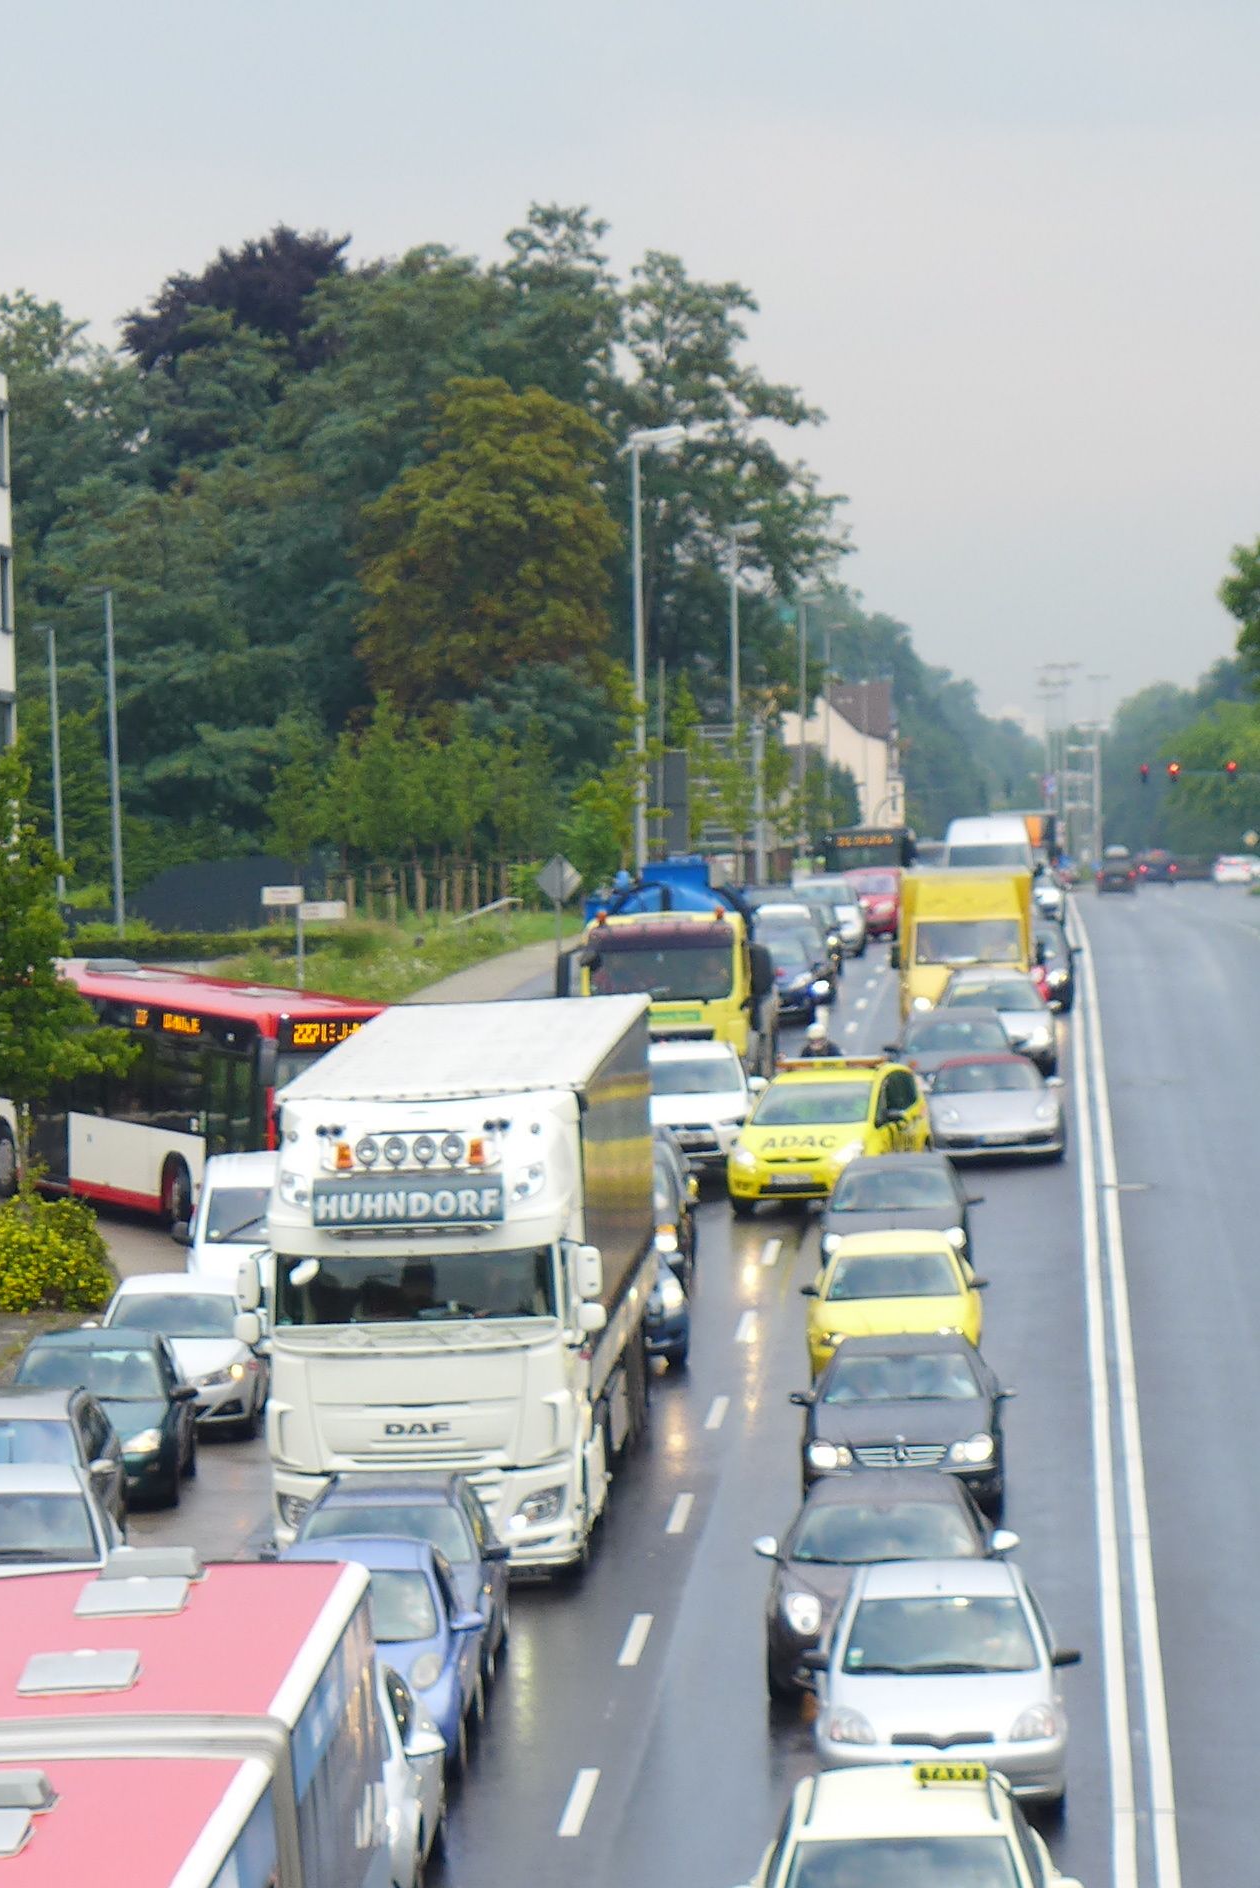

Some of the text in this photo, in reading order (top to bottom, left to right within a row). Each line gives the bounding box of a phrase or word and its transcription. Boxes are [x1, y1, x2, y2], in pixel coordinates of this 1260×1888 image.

[761, 1135, 838, 1150] ADAC
[316, 1188, 500, 1221] HUHNDORF
[384, 1421, 451, 1435] DAF
